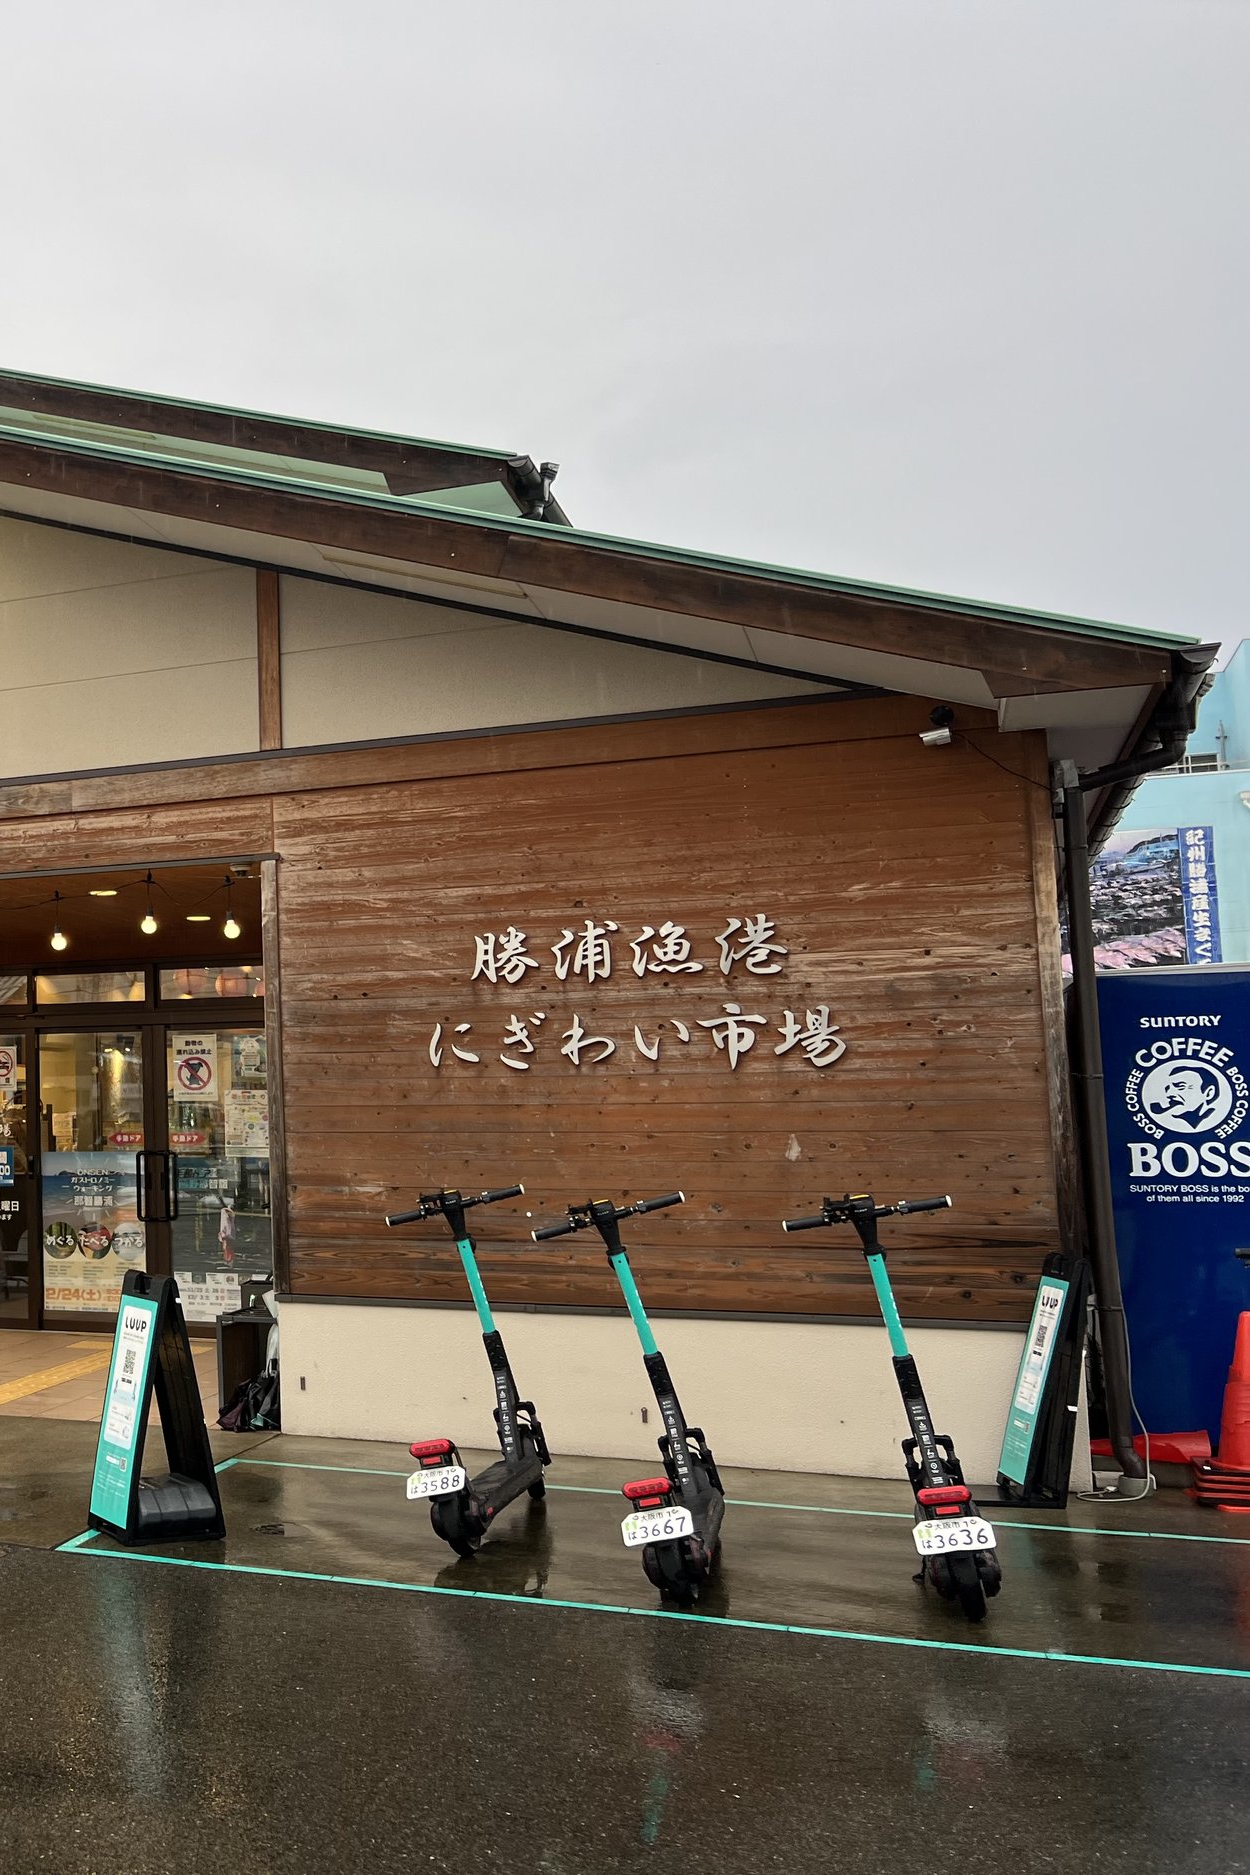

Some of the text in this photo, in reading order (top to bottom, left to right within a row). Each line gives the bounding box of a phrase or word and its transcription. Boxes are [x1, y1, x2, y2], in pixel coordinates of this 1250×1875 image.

[470, 913, 789, 984] 勝浦漁港
[1139, 1015, 1221, 1028] SUNTORY
[429, 1003, 847, 1071] にぎわい市場
[1135, 1037, 1235, 1067] COFFEE
[1125, 1068, 1164, 1140] BOSS COFFEE
[1214, 1066, 1249, 1140] BOSS COFFEE
[1127, 1141, 1250, 1177] BOSS
[1130, 1185, 1179, 1193] SUNTORY
[1180, 1185, 1209, 1193] BOSS
[1211, 1185, 1219, 1193] is
[1221, 1185, 1236, 1193] the
[73, 1195, 113, 1207] 那智勝浦
[1146, 1195, 1245, 1203] of them all since 1992
[46, 1234, 75, 1246] めぐる
[79, 1235, 109, 1247] たべる
[114, 1236, 143, 1248] つかる
[125, 1316, 147, 1332] LUUP
[410, 1474, 460, 1495] は 3588
[640, 1512, 664, 1522] 大阪市
[628, 1516, 686, 1541] は 3667
[934, 1521, 960, 1530] 大阪市
[921, 1528, 989, 1549] は 3636
